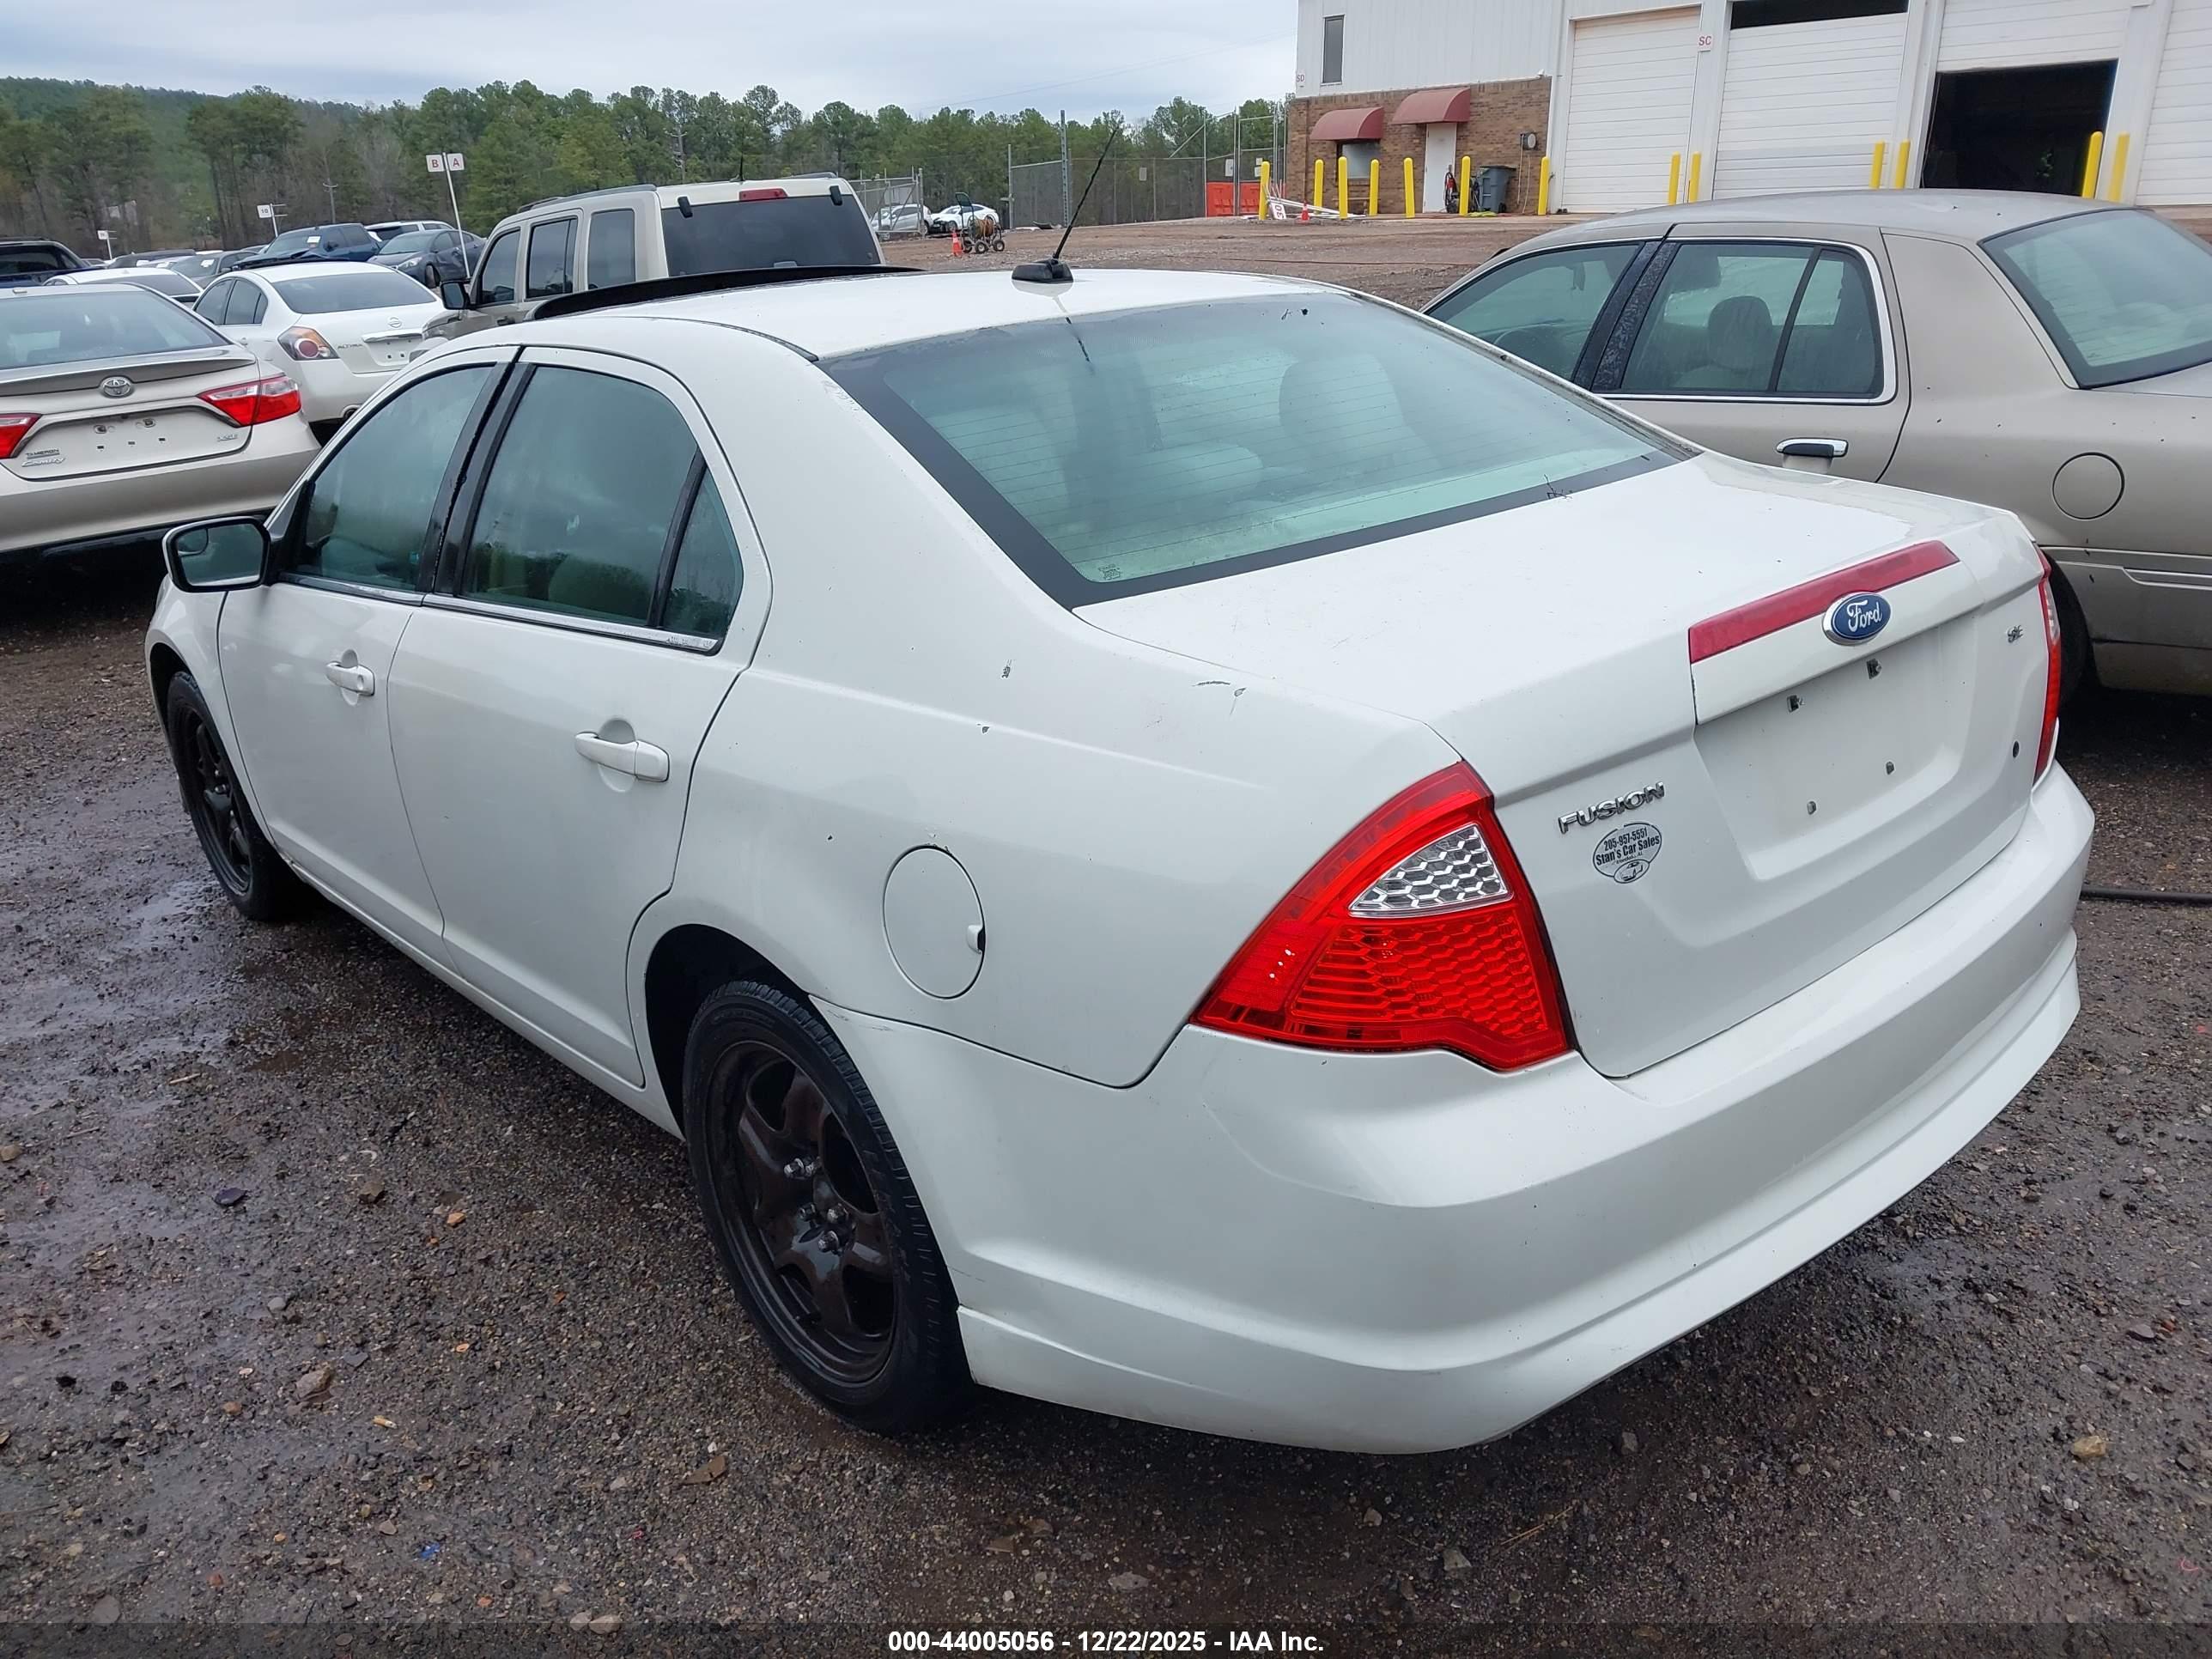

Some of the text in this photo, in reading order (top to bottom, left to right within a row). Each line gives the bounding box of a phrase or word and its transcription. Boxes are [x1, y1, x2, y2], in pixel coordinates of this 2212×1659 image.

[1698, 35, 1711, 46] SC
[432, 159, 440, 168] B
[453, 157, 460, 167] A
[1846, 599, 1883, 633] Ford
[1558, 781, 1665, 835] FUSION
[1595, 836, 1660, 866] Stan's Car Sales
[1603, 827, 1648, 852] 205-957-5551
